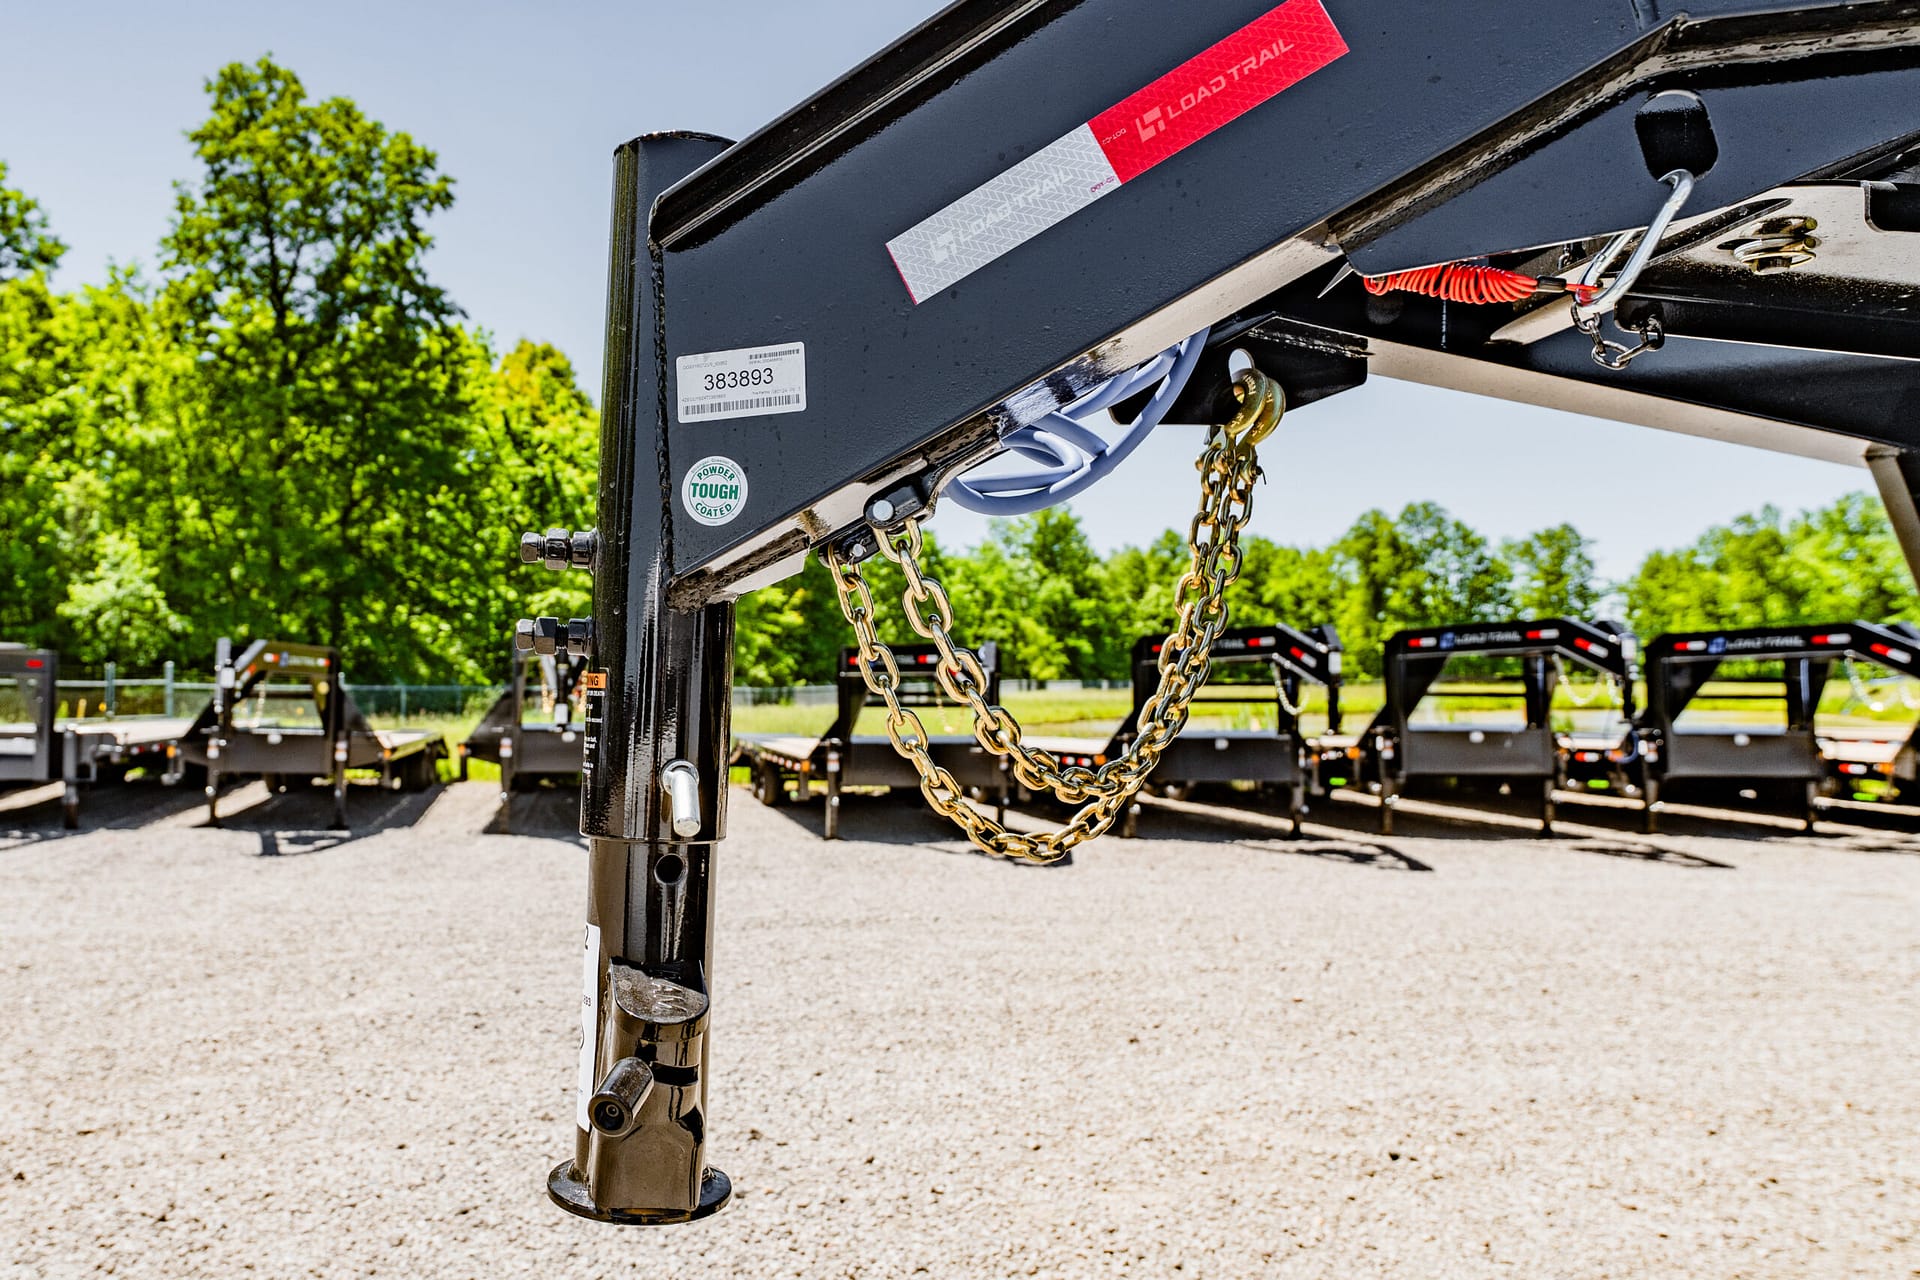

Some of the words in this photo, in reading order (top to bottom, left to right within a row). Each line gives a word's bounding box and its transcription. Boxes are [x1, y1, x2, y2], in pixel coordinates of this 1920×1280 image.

[1167, 77, 1227, 120] LOAD
[1226, 38, 1295, 82] TRAIL
[958, 201, 1012, 244] LOAD
[1012, 166, 1074, 208] TRAIL
[703, 367, 774, 391] 383893
[696, 465, 736, 482] POWDER
[691, 482, 739, 500] TOUGH
[695, 502, 732, 517] COATED
